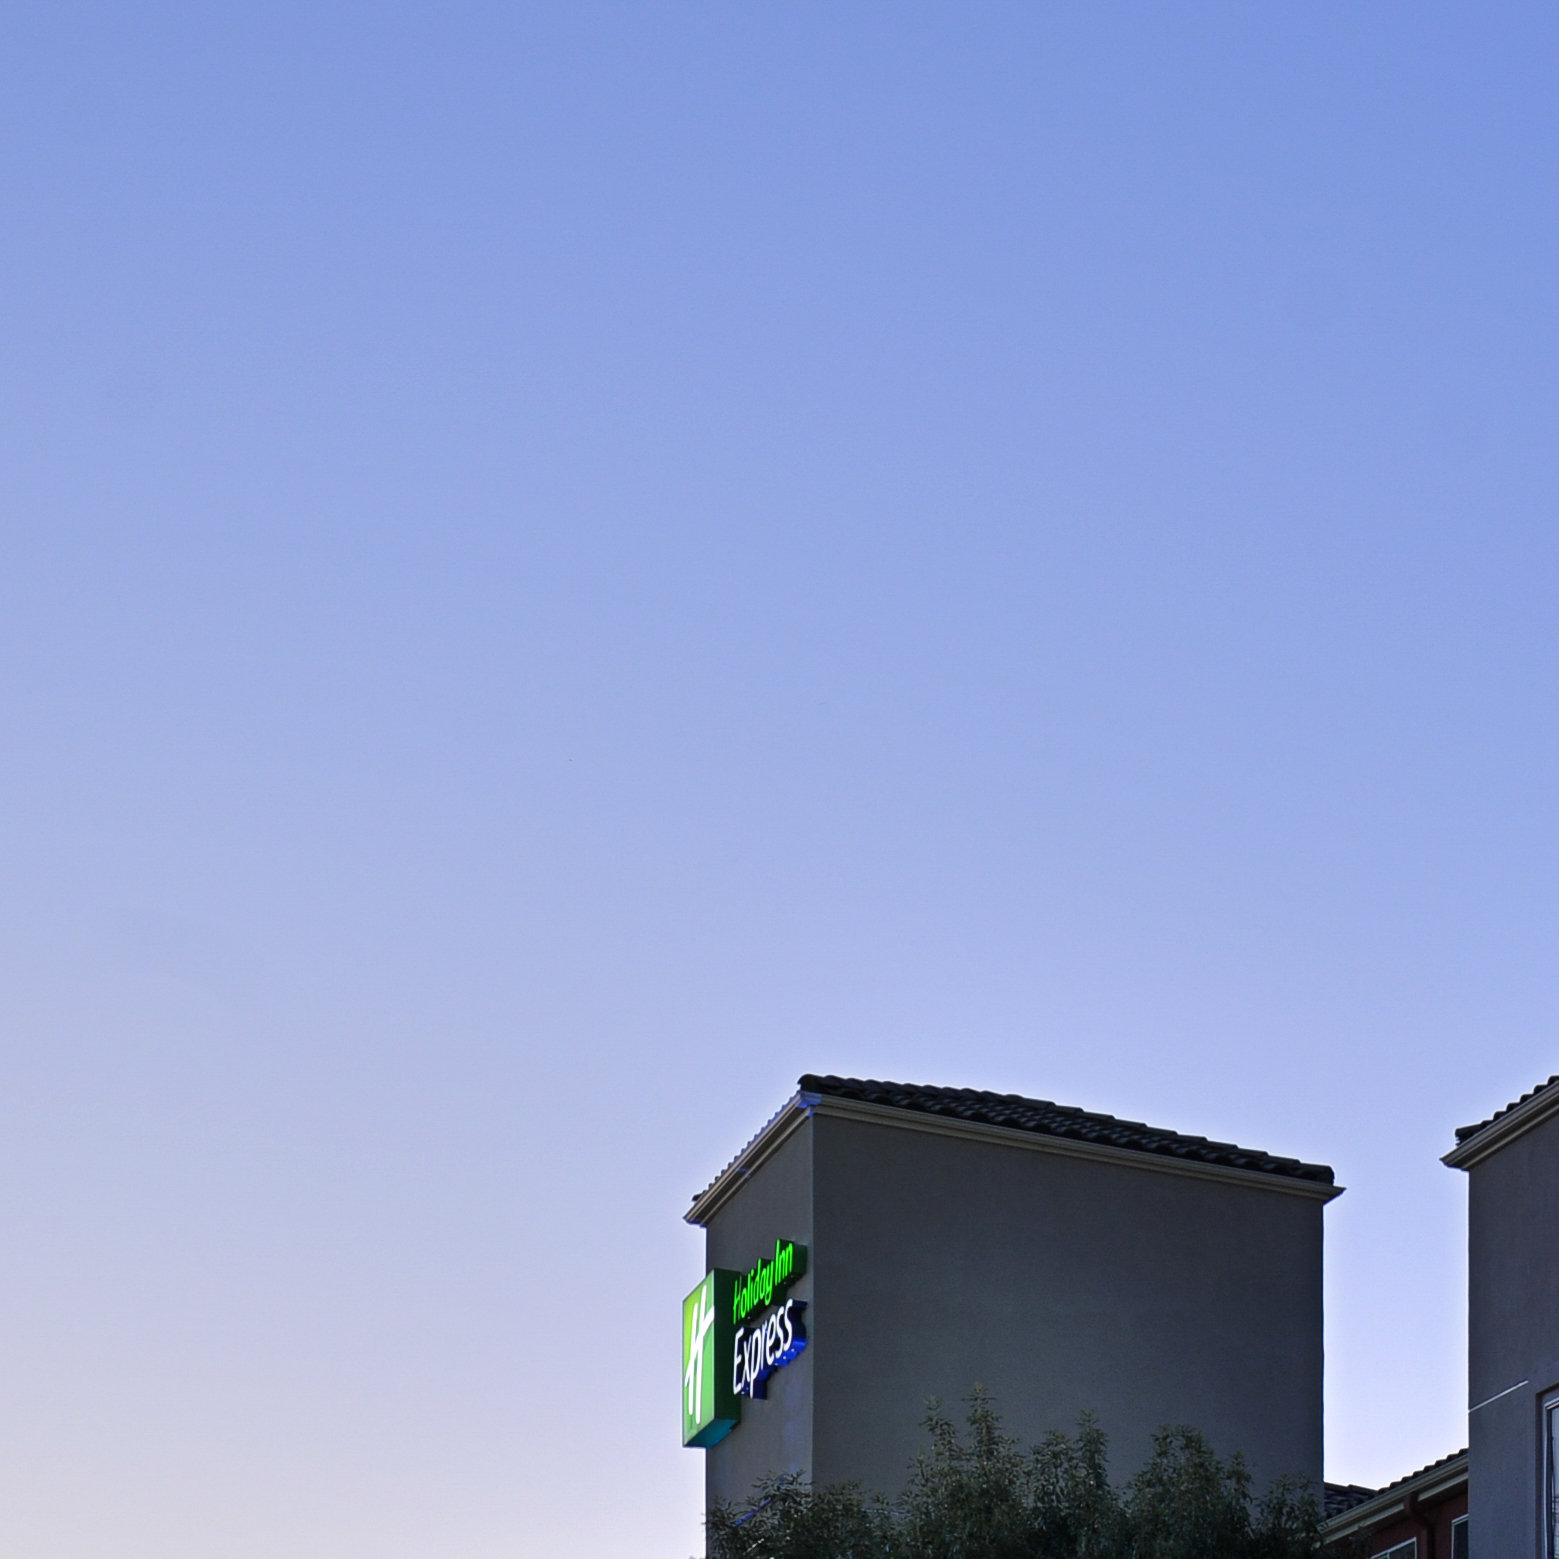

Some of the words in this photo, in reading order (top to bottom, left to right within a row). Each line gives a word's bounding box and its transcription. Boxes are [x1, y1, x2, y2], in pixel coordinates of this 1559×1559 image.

[733, 1258, 774, 1325] Holiday
[774, 1239, 793, 1286] Inn
[733, 1298, 793, 1399] Express
